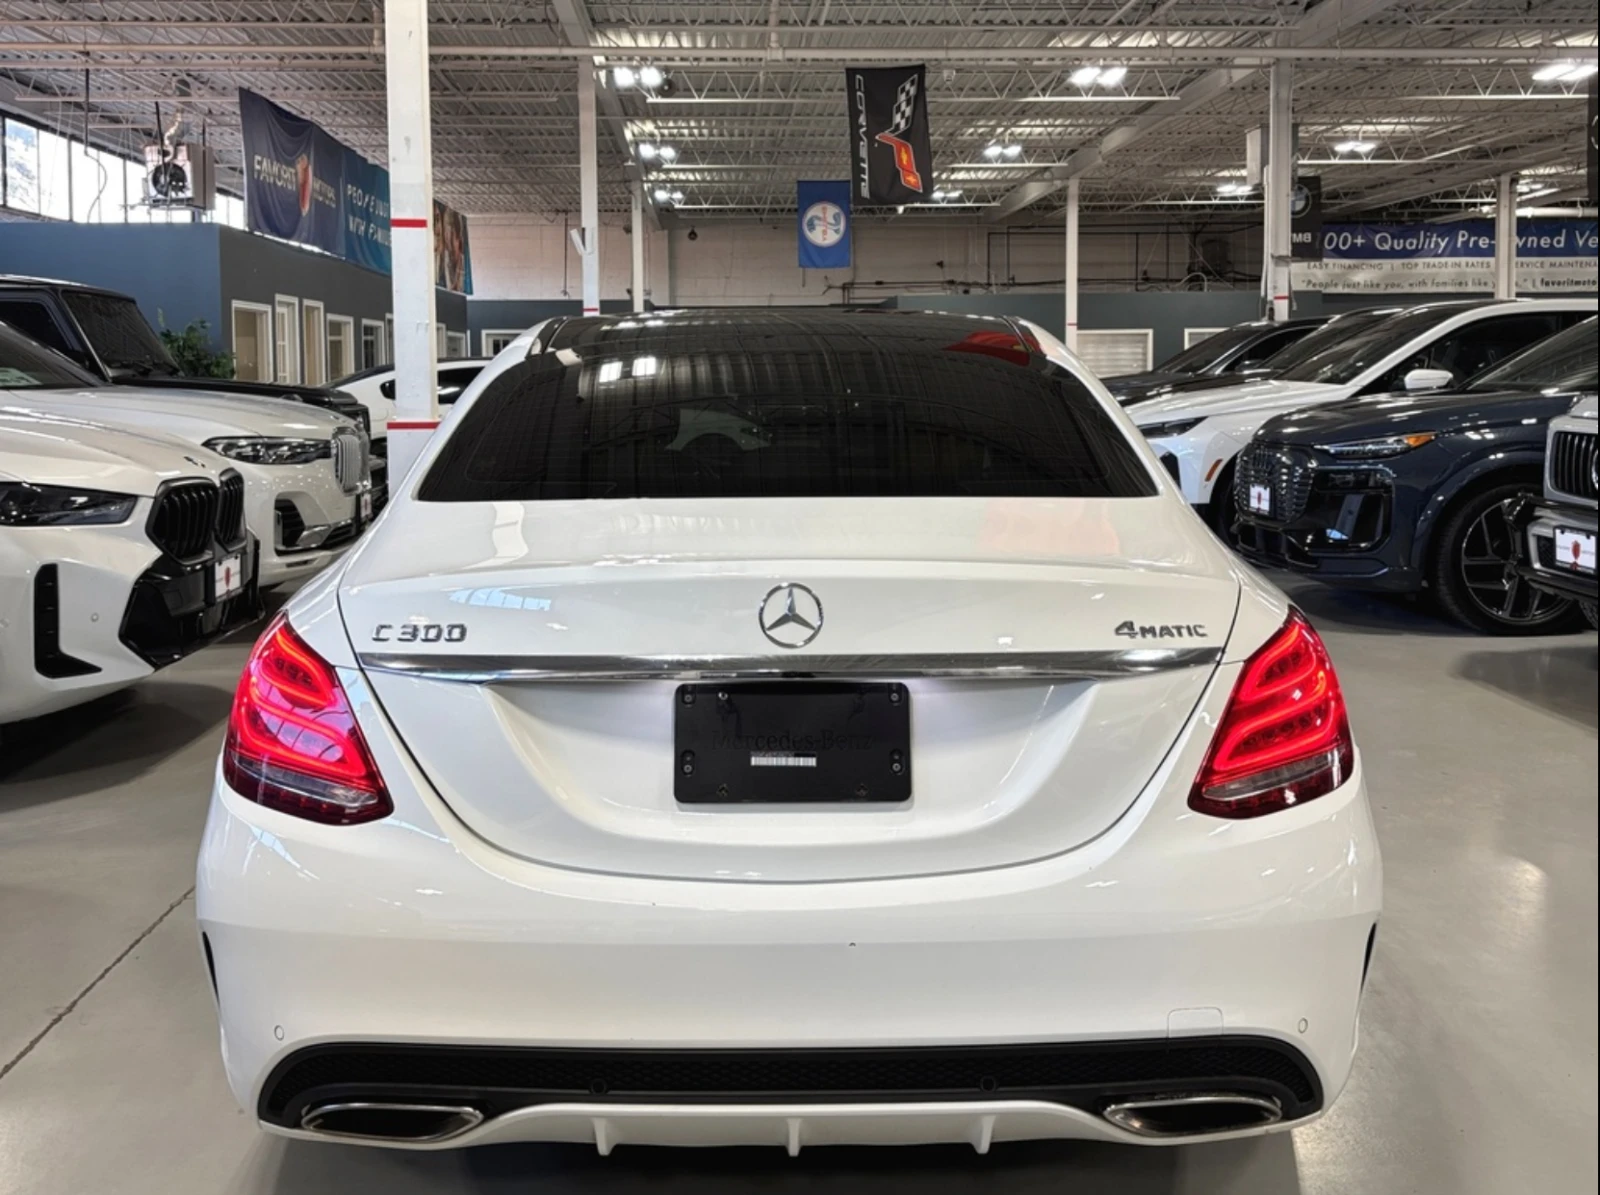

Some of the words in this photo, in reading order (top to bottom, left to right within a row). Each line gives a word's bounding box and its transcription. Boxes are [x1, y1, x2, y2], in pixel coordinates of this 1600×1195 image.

[1324, 232, 1366, 250] 00+
[1374, 230, 1449, 254] Quality
[1307, 262, 1328, 270] EASY
[1333, 262, 1383, 270] FINANCING
[1401, 262, 1419, 270] TOP
[1465, 261, 1491, 269] RATES
[1515, 260, 1545, 269] ERVICE
[1341, 280, 1361, 290] just
[1363, 279, 1380, 289] like
[1408, 278, 1428, 288] with
[1431, 278, 1469, 288] families
[1471, 277, 1486, 288] like
[372, 624, 393, 642] C
[397, 623, 467, 642] 300
[1115, 620, 1208, 639] 4MATIC
[711, 729, 873, 751] Mercedes-Benz
